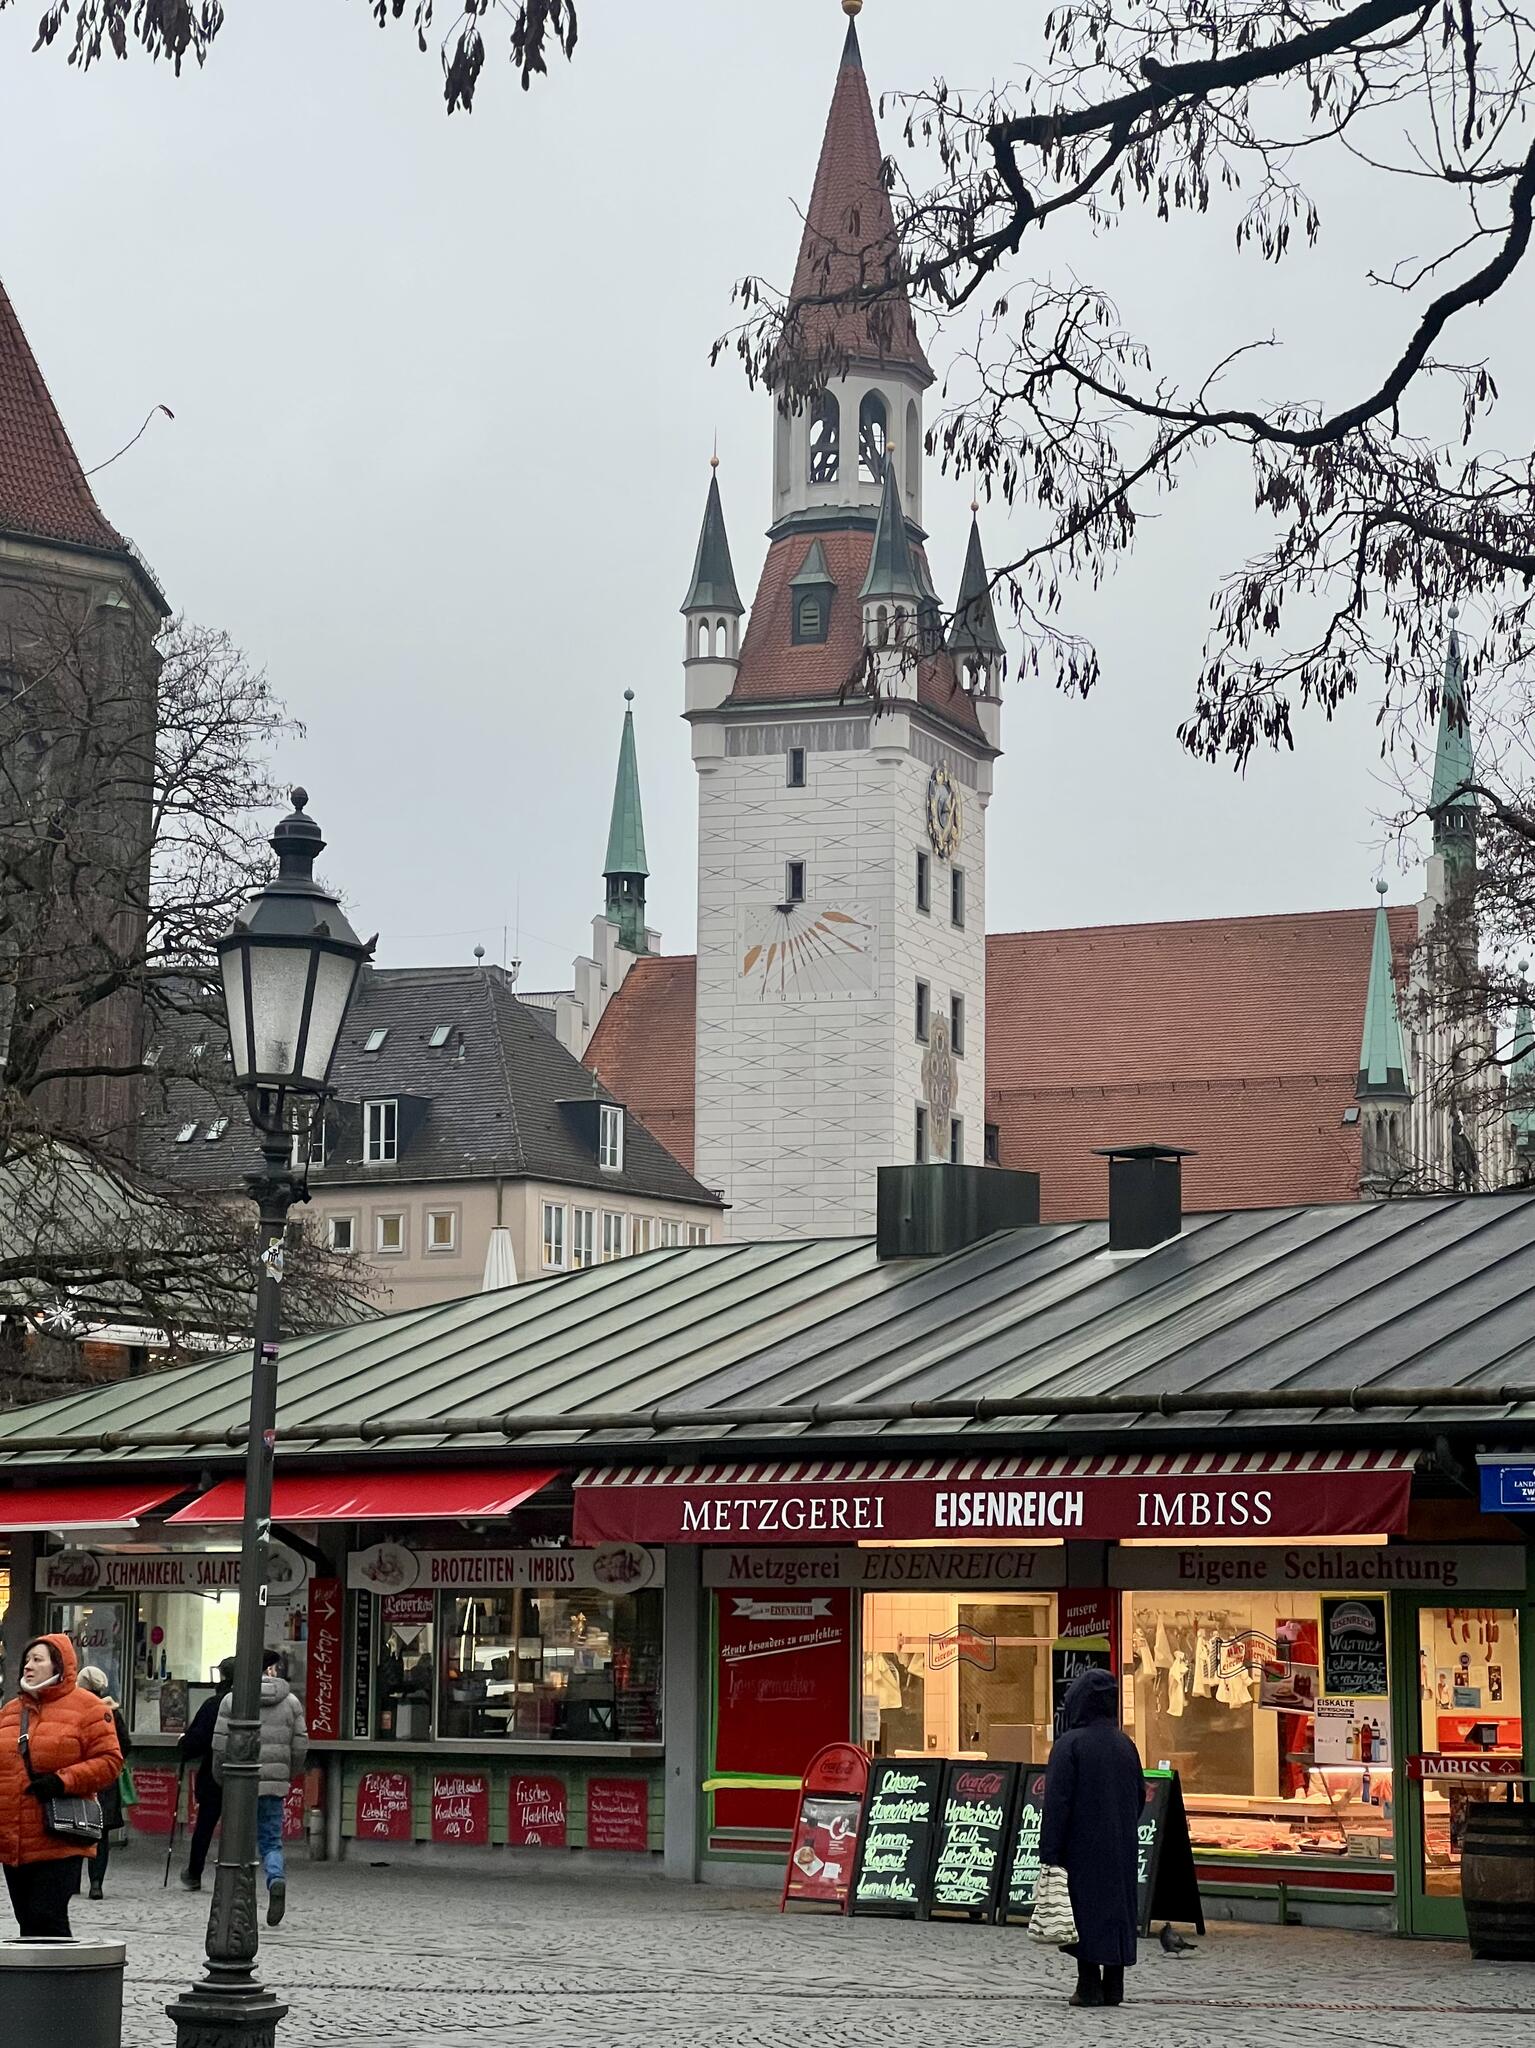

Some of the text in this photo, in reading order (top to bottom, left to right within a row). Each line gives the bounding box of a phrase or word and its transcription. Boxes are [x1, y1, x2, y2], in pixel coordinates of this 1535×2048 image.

[680, 1491, 1273, 1532] METZGEREI EISENREICH IMBISS
[105, 1560, 241, 1586] SCHMANKERL SALATE
[431, 1556, 576, 1583] BROTZEITEN IMBISS
[728, 1552, 1037, 1585] Metzgerei EISENREICH
[1178, 1552, 1459, 1586] Eigene Schlachtung
[1066, 1602, 1098, 1618] unsere
[1060, 1617, 1111, 1638] Angebote
[721, 1627, 843, 1656] Heute besonders zu empfehlen:
[1329, 1634, 1384, 1652] Warmer
[1317, 1698, 1355, 1708] EISKALTE
[1420, 1759, 1491, 1776] IMBISS
